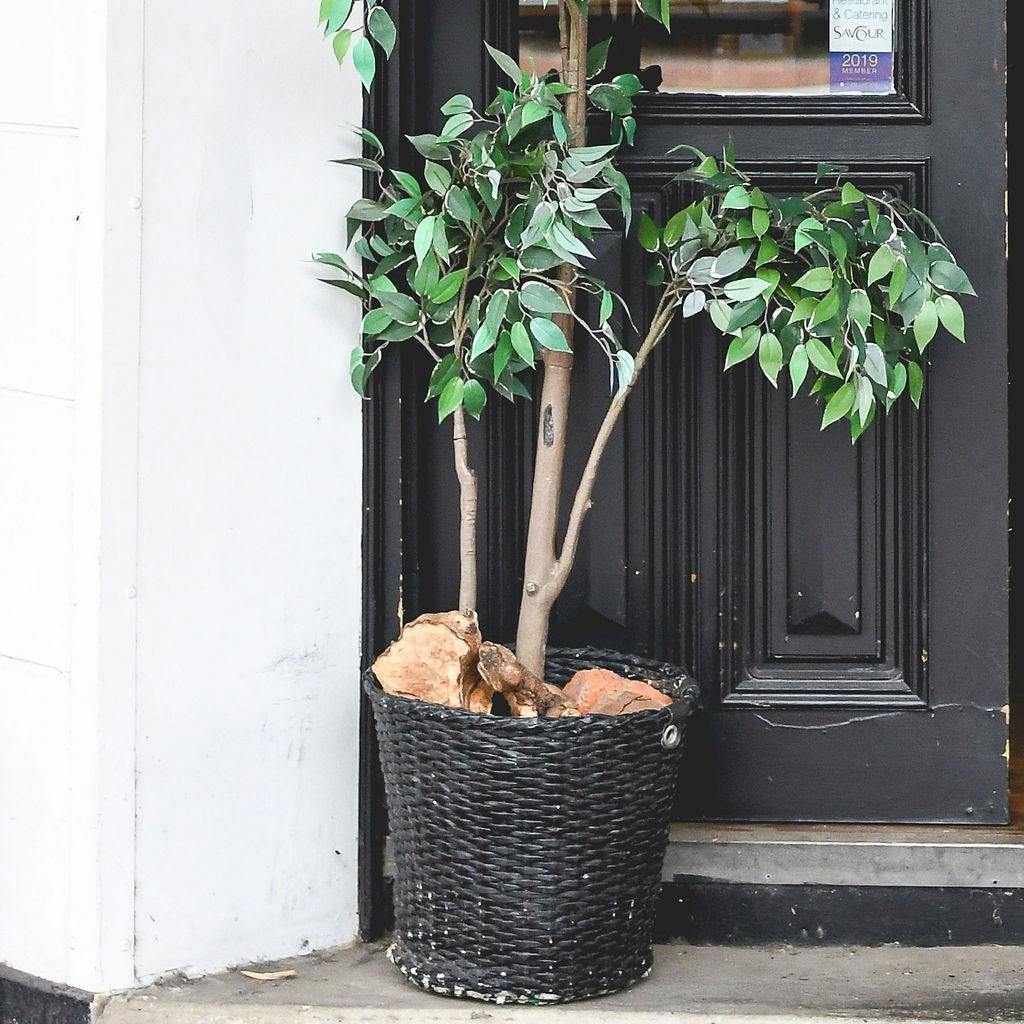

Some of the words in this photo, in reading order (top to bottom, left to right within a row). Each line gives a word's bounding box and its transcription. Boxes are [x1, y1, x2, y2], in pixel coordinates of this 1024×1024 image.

[832, 7, 841, 20] &
[844, 8, 888, 22] Catering
[842, 54, 878, 67] 2019
